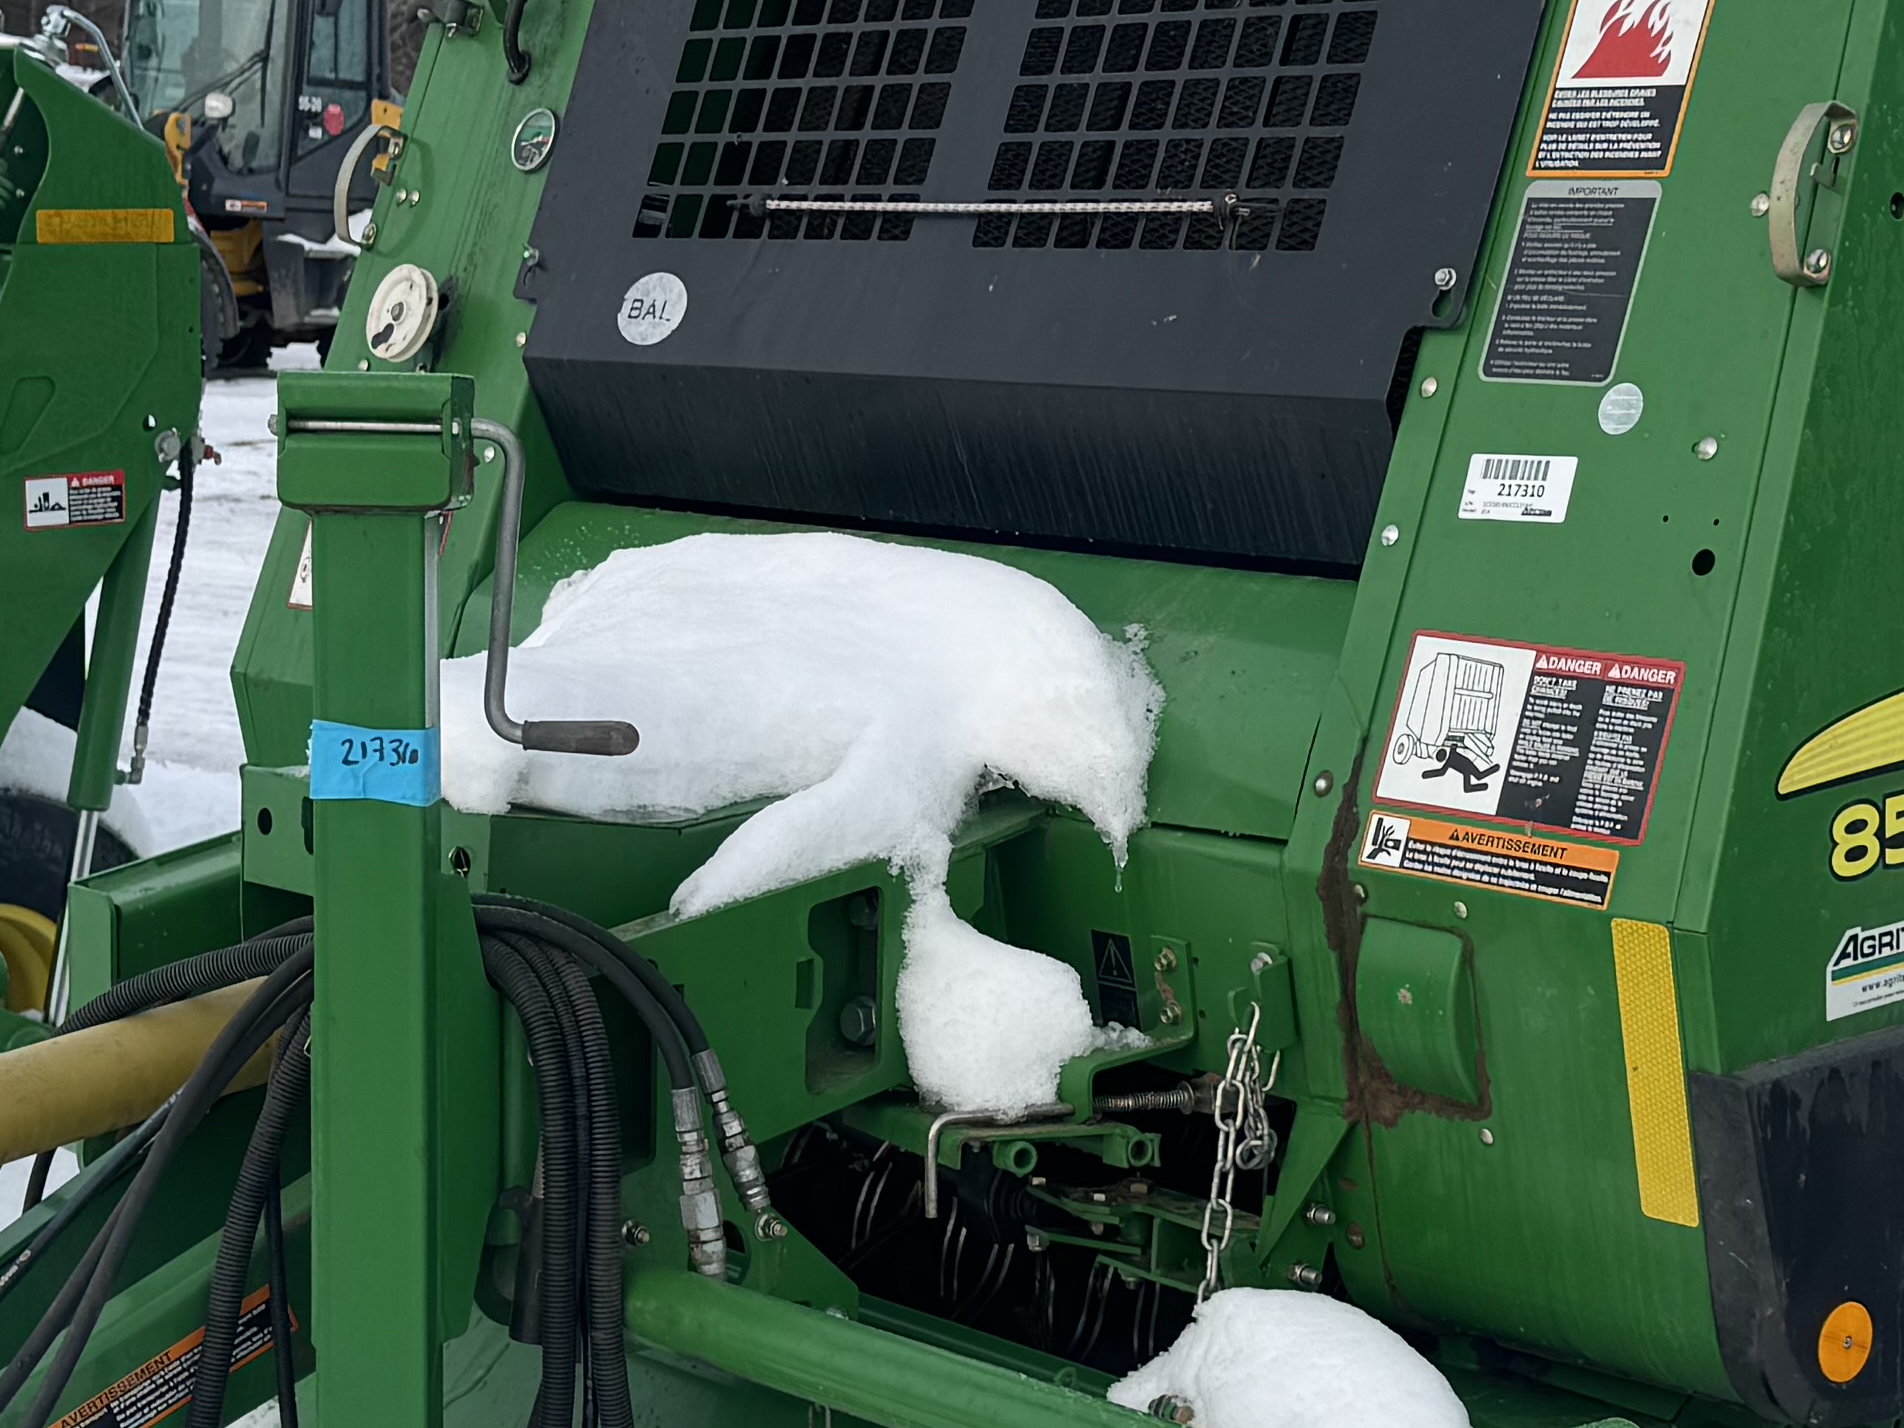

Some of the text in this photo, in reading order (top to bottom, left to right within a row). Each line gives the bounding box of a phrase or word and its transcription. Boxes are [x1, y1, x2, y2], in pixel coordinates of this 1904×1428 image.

[1568, 187, 1619, 196] IMPORTANT
[1497, 483, 1545, 498] 217310
[1549, 657, 1602, 675] DANGER
[1622, 665, 1677, 684] DANGER
[1462, 831, 1568, 860] AVERTISSEMENT
[61, 1350, 173, 1428] AVERTISSEMENT
